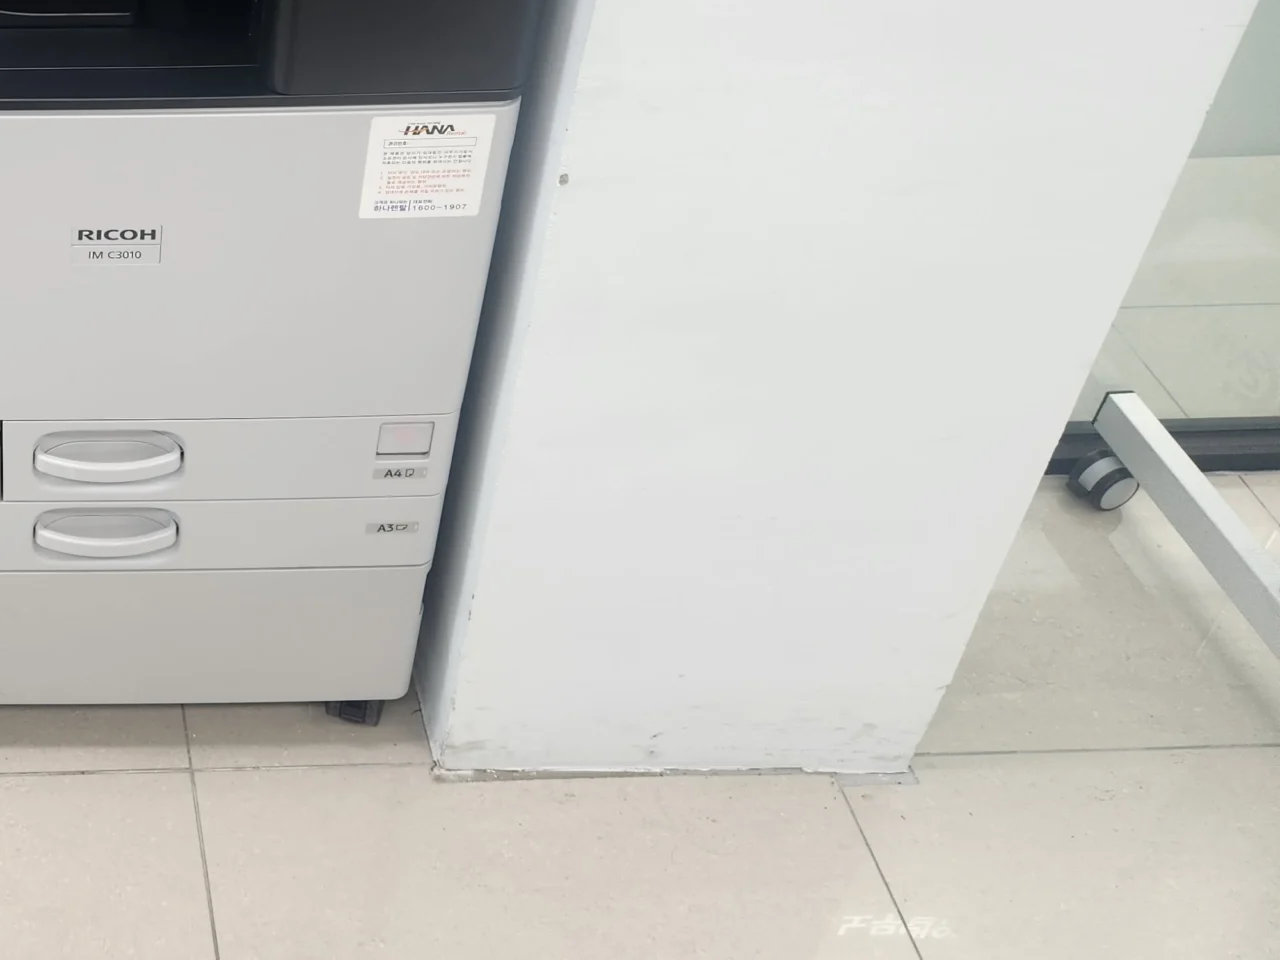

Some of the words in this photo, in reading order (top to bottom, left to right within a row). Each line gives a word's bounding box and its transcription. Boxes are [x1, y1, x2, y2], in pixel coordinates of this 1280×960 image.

[404, 124, 455, 135] HANA
[374, 204, 407, 212] 하나렌탈
[78, 229, 156, 241] RICOH
[88, 251, 104, 259] IM
[108, 251, 142, 259] C3010
[384, 469, 402, 478] A4
[377, 524, 394, 532] A3
